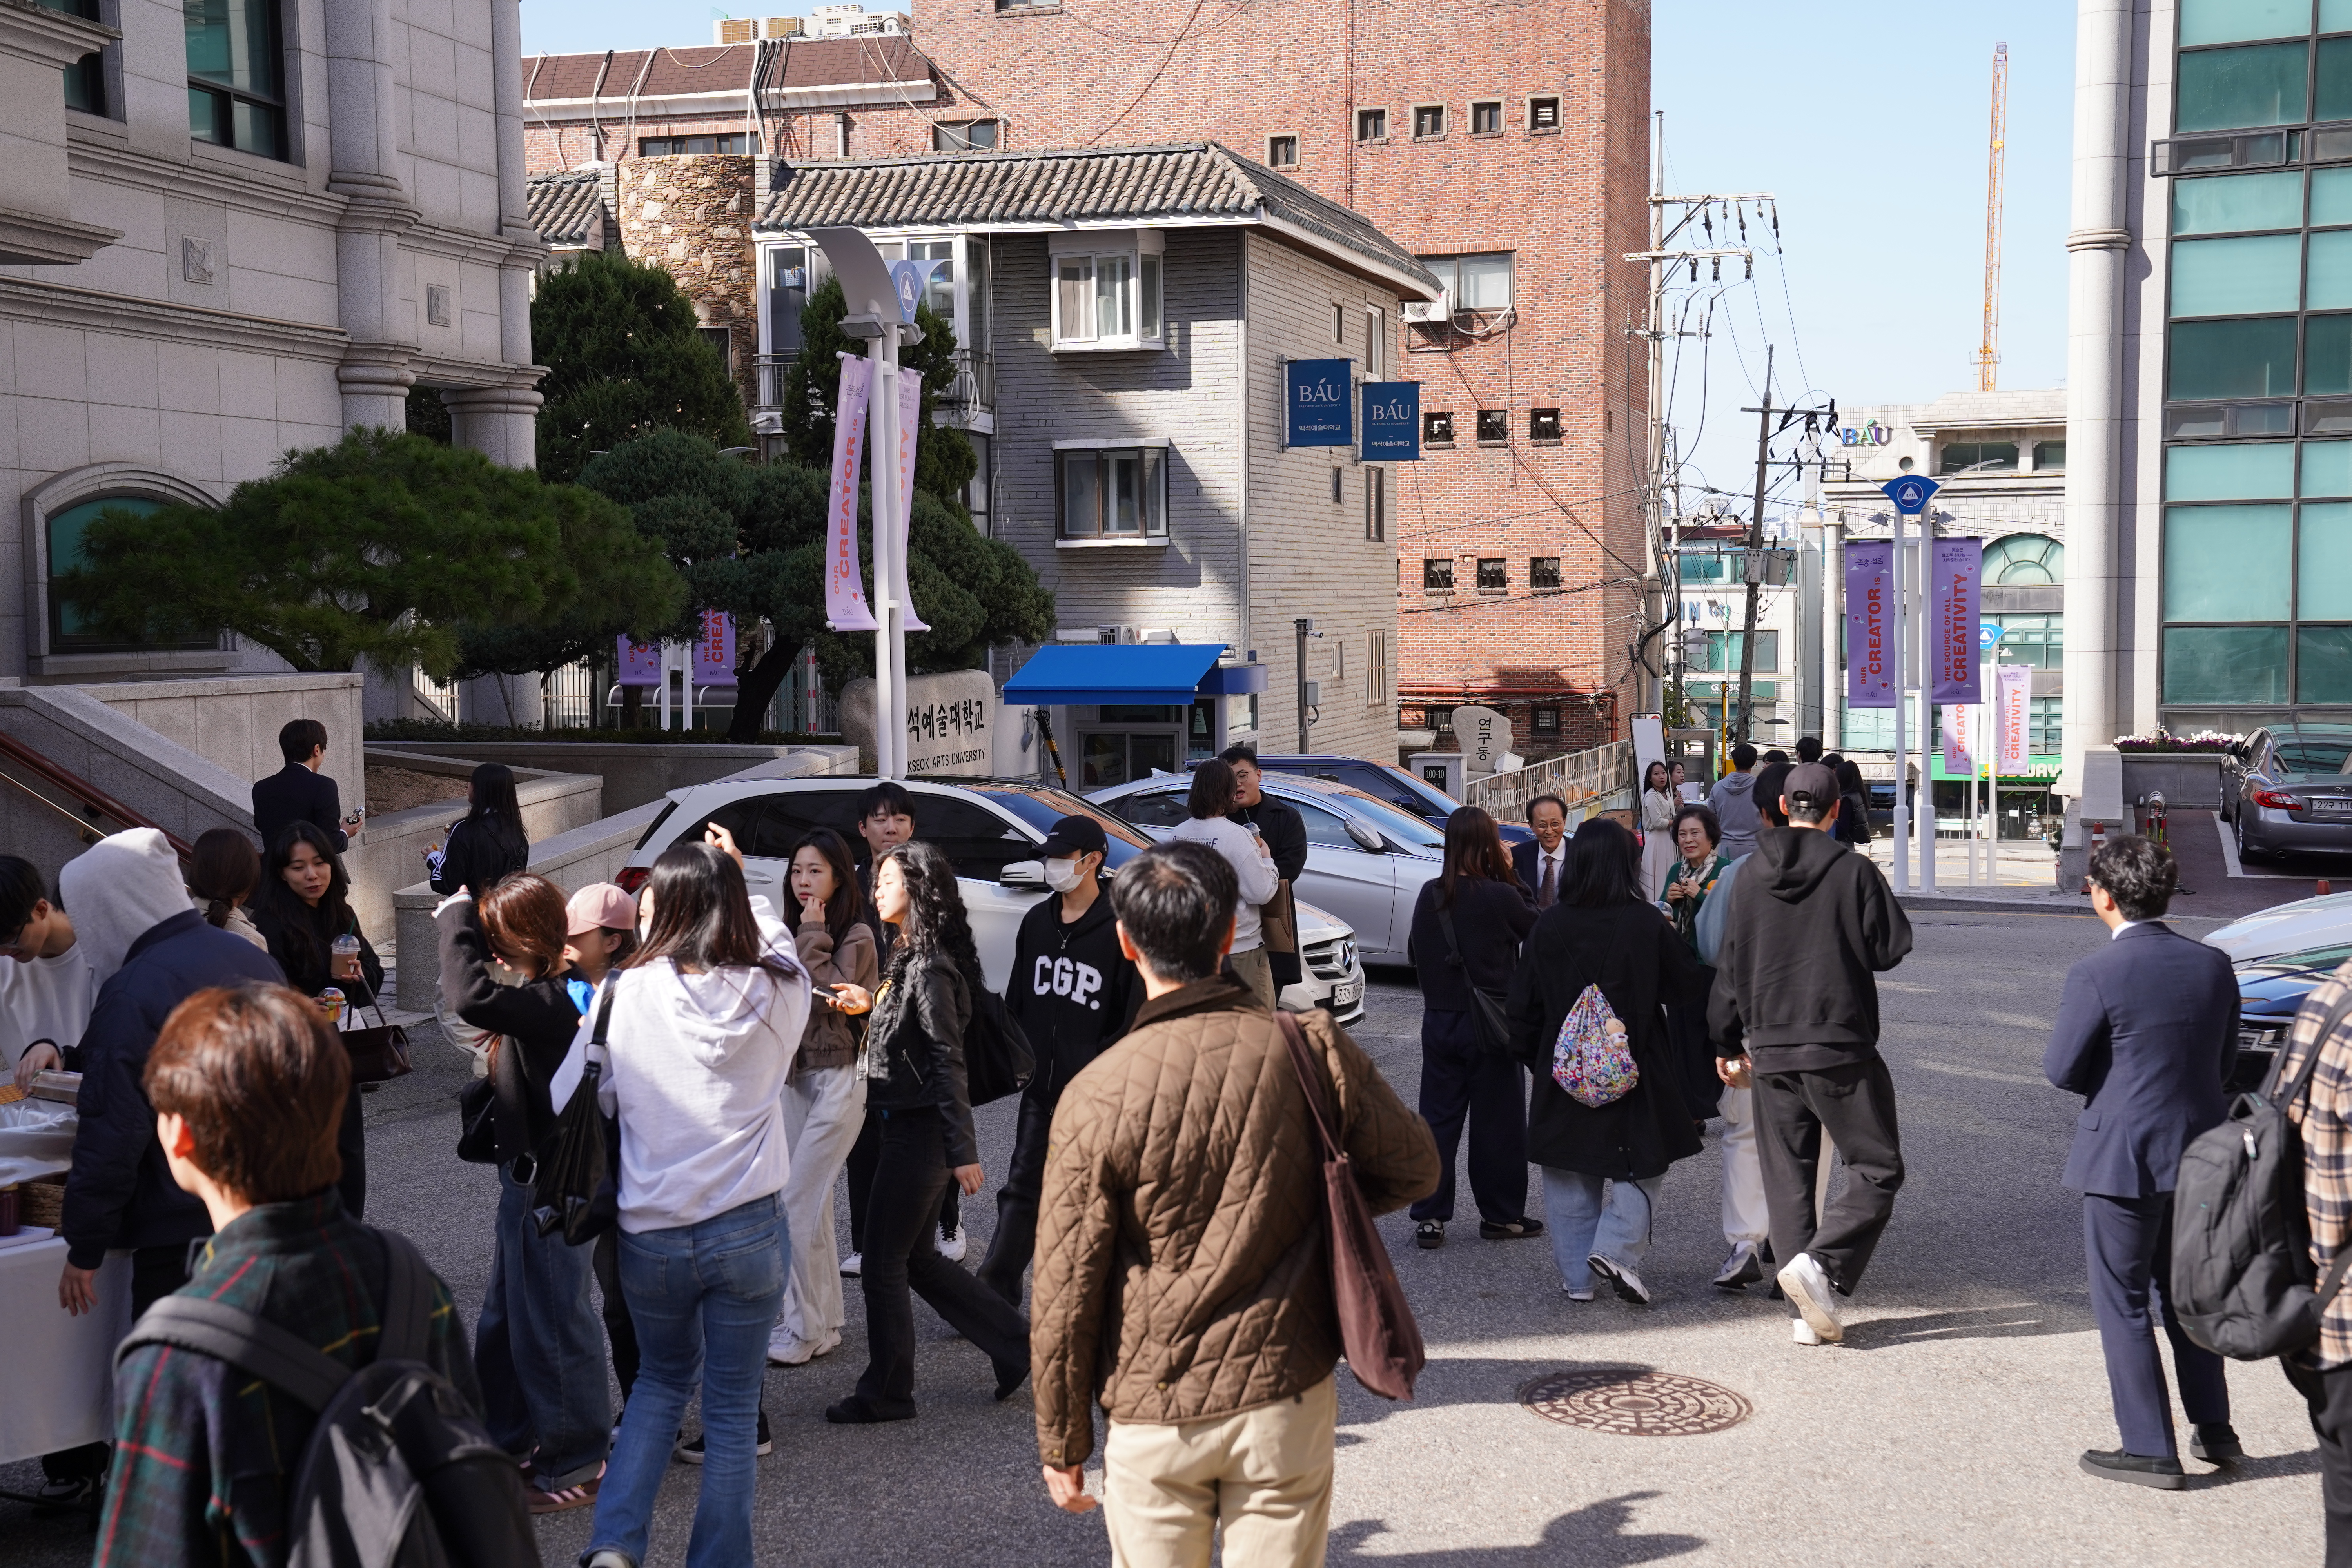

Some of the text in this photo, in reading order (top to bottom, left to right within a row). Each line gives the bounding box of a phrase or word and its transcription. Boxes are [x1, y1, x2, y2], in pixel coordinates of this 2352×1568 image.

[840, 418, 858, 579] CREATOR IS
[1867, 588, 1882, 675] CREATOR
[1945, 615, 1951, 626] OF
[1953, 574, 1967, 682] CREATIVITY
[1476, 717, 1492, 761] 연구동
[2011, 689, 2021, 759] CREATIVITY
[932, 754, 949, 768] ARTS
[951, 748, 985, 765] UNIVERSITY
[1426, 769, 1445, 779] 100-10
[1034, 955, 1103, 1011] CGP.
[1338, 987, 1351, 1002] 33어
